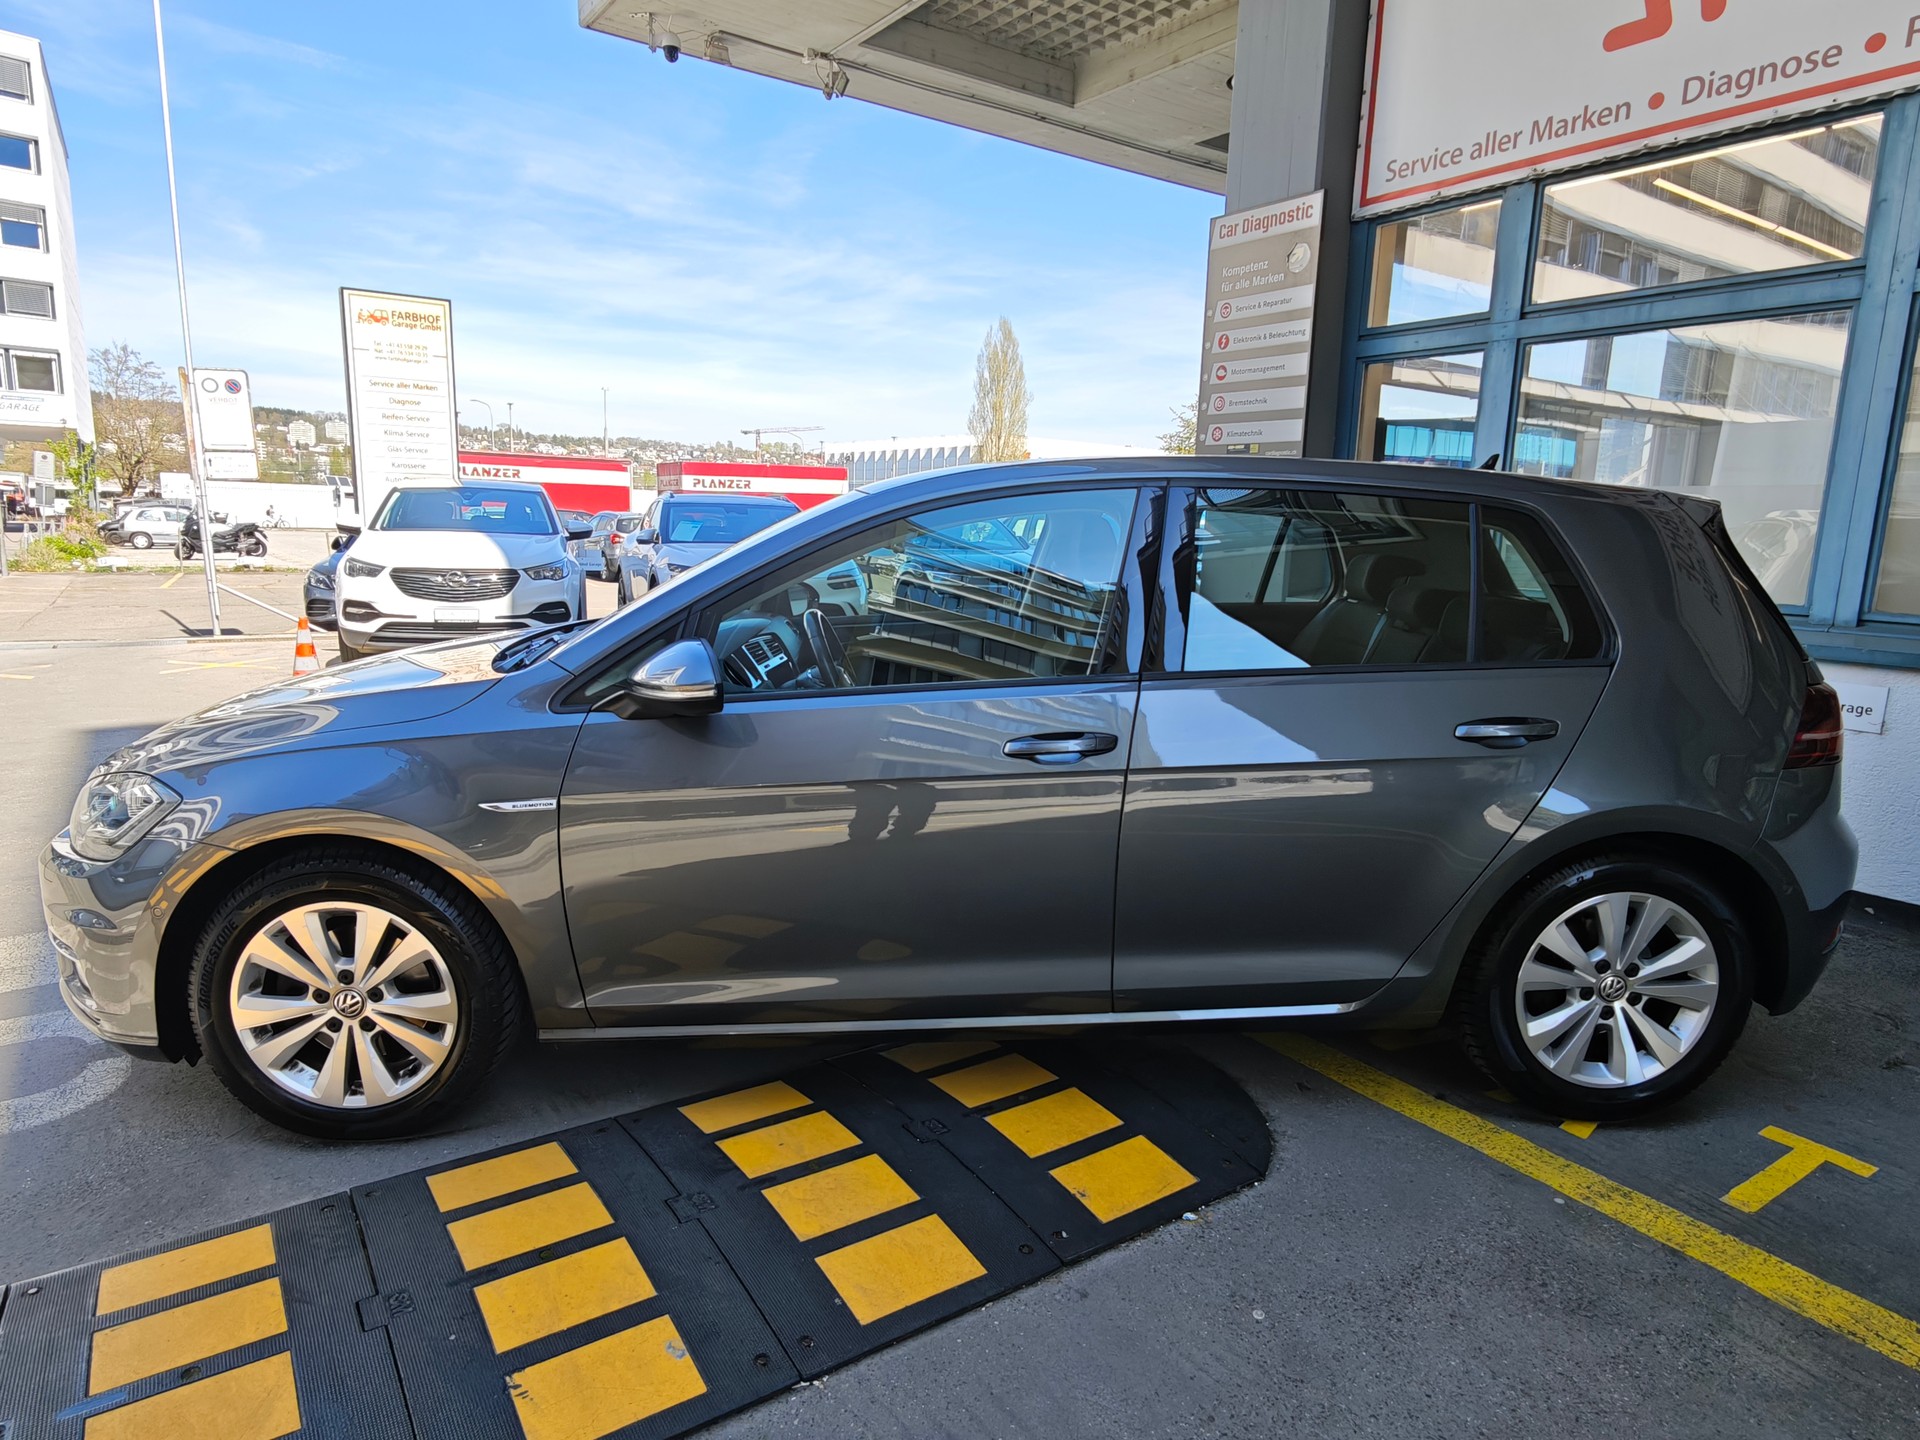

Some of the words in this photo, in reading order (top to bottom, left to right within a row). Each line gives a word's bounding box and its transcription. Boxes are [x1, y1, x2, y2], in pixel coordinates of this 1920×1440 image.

[1384, 144, 1463, 184] Service
[1469, 125, 1523, 161] aller
[1529, 101, 1632, 147] Marken
[1681, 43, 1843, 106] Diagnose
[1219, 222, 1240, 240] Car
[1242, 202, 1314, 234] Diagnostic
[1222, 260, 1269, 278] Kompetenz
[1221, 282, 1233, 293] für
[1235, 278, 1250, 290] alle
[1252, 273, 1285, 287] Marken
[1235, 303, 1256, 313] Service
[1263, 297, 1293, 308] Reparatur
[391, 310, 441, 325] FARBHOF
[391, 320, 418, 330] Garage
[419, 323, 442, 332] GmbH
[1233, 335, 1262, 345] Elektronik
[1268, 329, 1306, 340] Beleuchtung
[1231, 364, 1286, 376] Motormanagement
[369, 379, 394, 388] Service
[413, 383, 438, 391] Marken
[0, 402, 41, 412] GARAGE
[389, 397, 421, 406] Diagnose
[1228, 397, 1268, 407] Bremstechnik
[1226, 429, 1263, 438] Klimatechnik
[458, 466, 521, 479] LANZER
[692, 478, 752, 489] PLANZER
